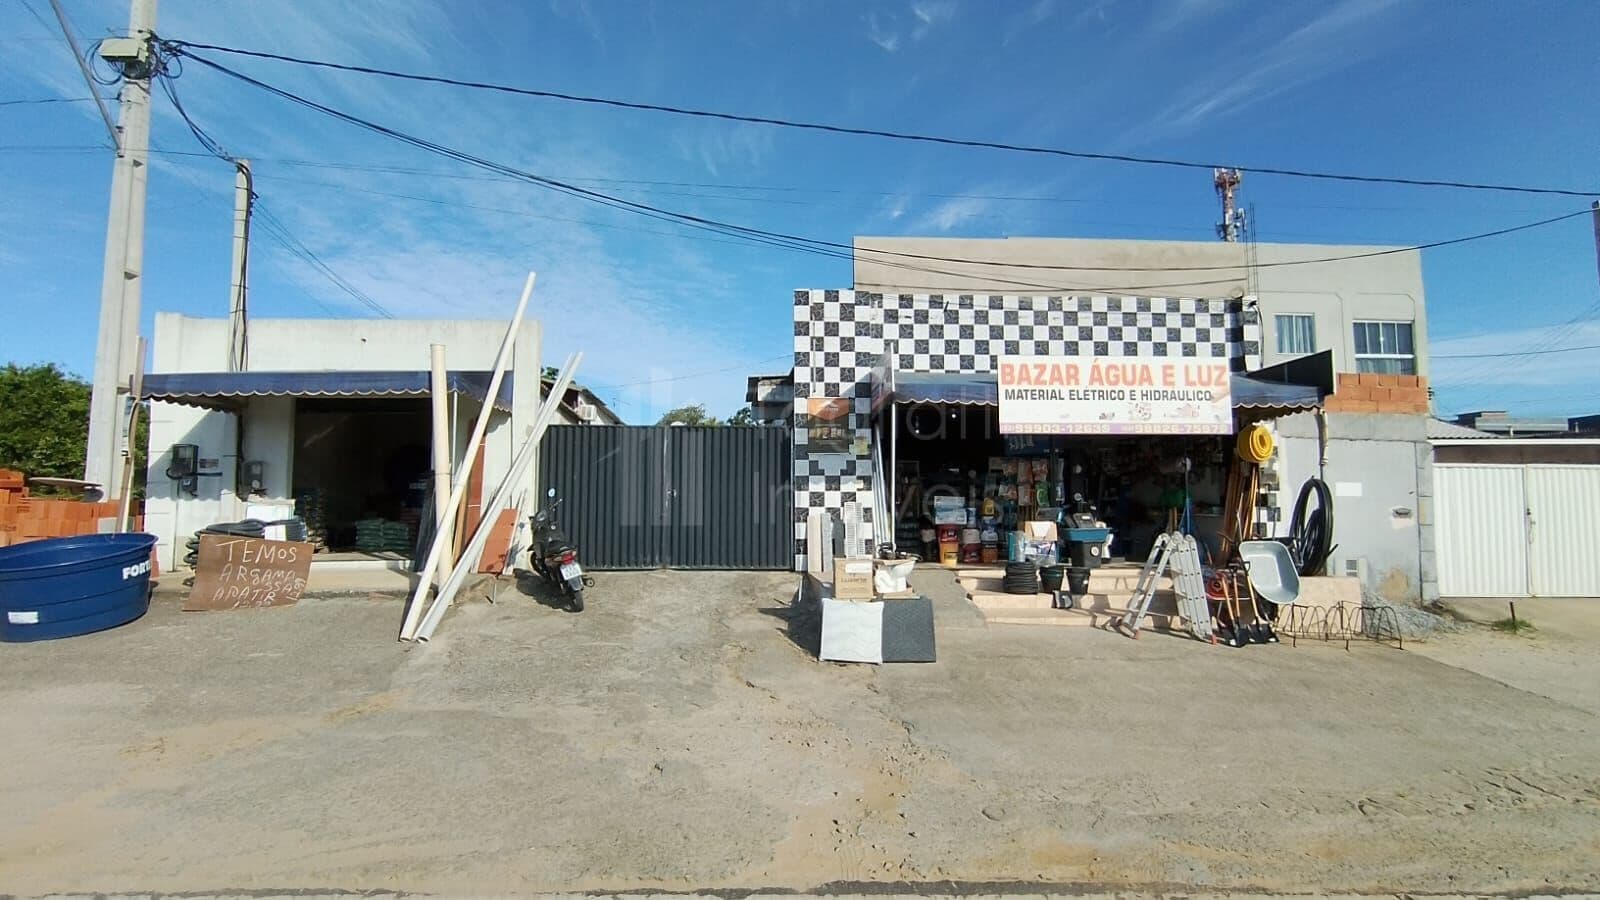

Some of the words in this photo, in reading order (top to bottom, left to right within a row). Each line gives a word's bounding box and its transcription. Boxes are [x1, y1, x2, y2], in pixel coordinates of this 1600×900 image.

[1001, 363, 1080, 386] BAZAR
[1088, 358, 1154, 387] ÁGUA
[1162, 364, 1175, 387] E
[1184, 364, 1227, 388] LUZ
[1004, 388, 1065, 401] MATERIAL
[1129, 390, 1137, 401] E
[215, 539, 297, 564] TEMOS
